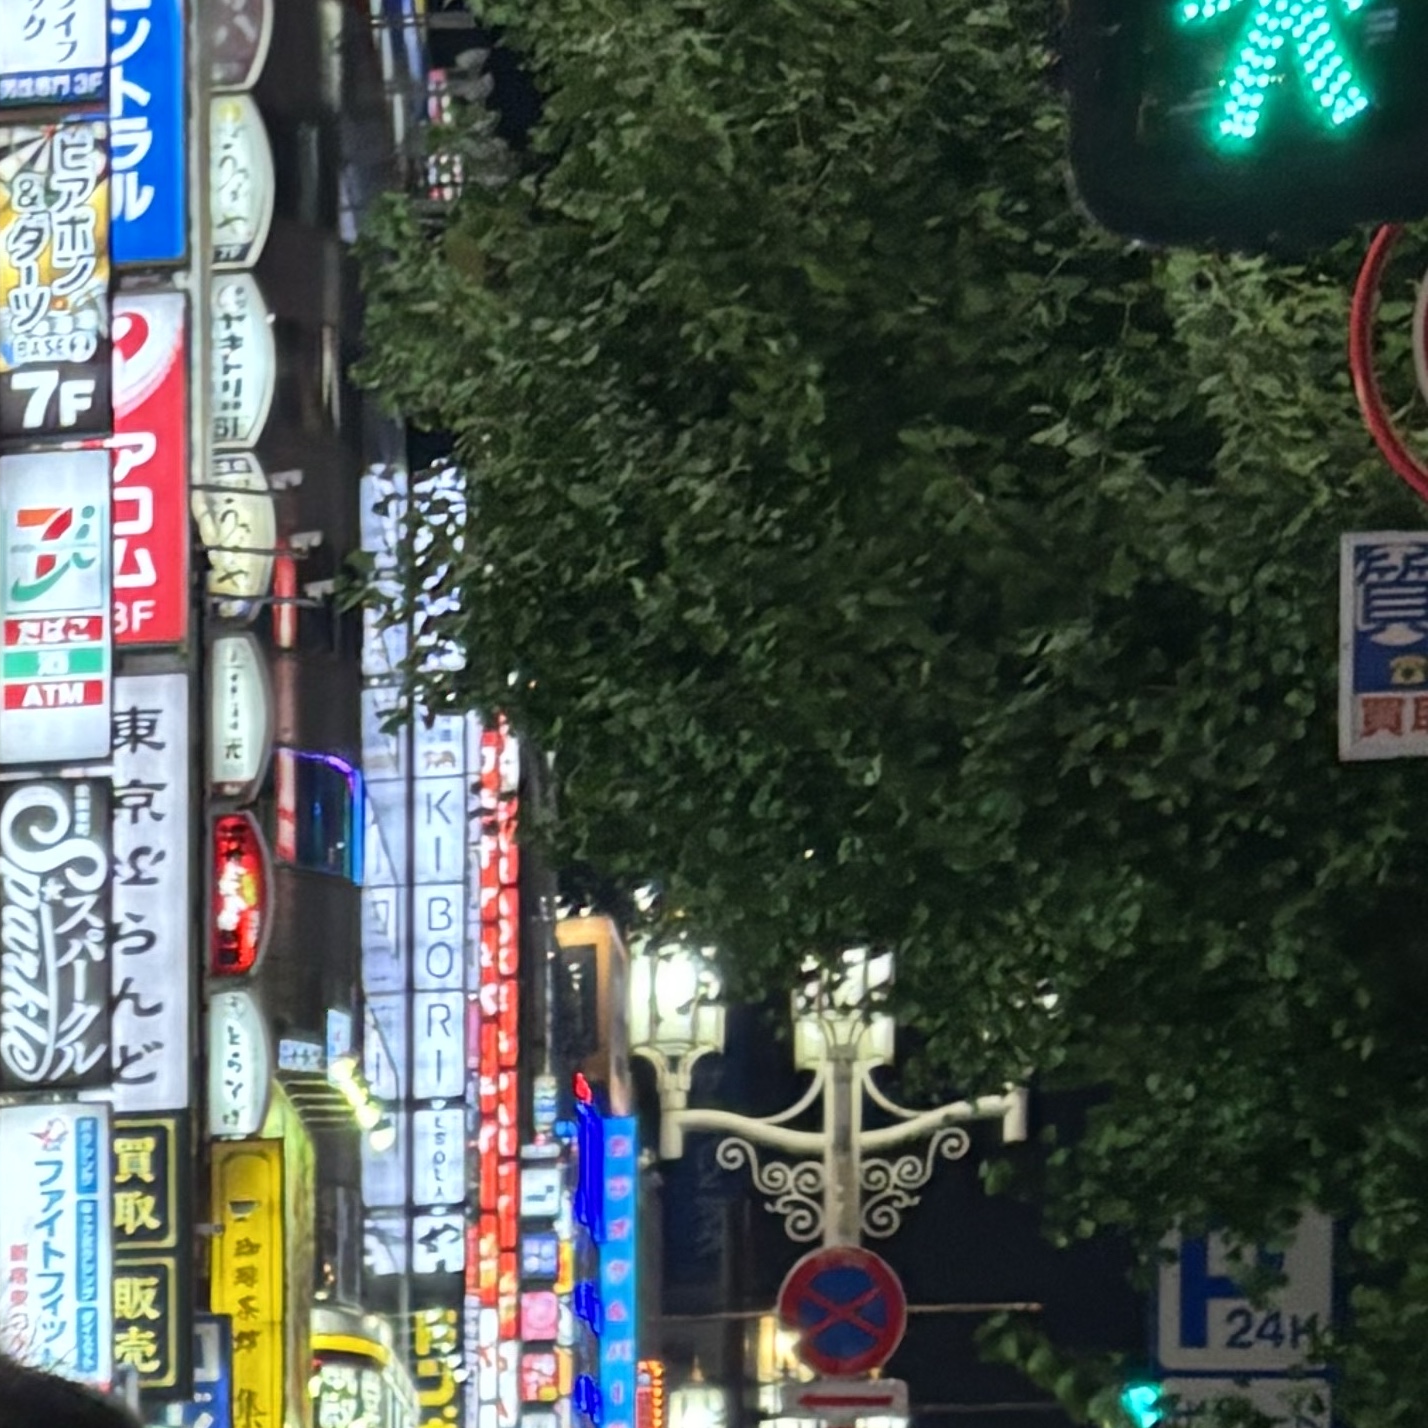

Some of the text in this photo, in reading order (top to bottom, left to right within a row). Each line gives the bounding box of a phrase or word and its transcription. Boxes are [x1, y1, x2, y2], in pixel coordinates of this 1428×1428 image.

[10, 370, 95, 428] 7F
[112, 432, 157, 588] アコム
[17, 618, 91, 645] たばこ
[21, 683, 85, 707] ATM
[424, 789, 454, 1085] KIBORI
[53, 894, 107, 1081] スパークル
[113, 1137, 161, 1235] 買取
[113, 1277, 161, 1373] 販売
